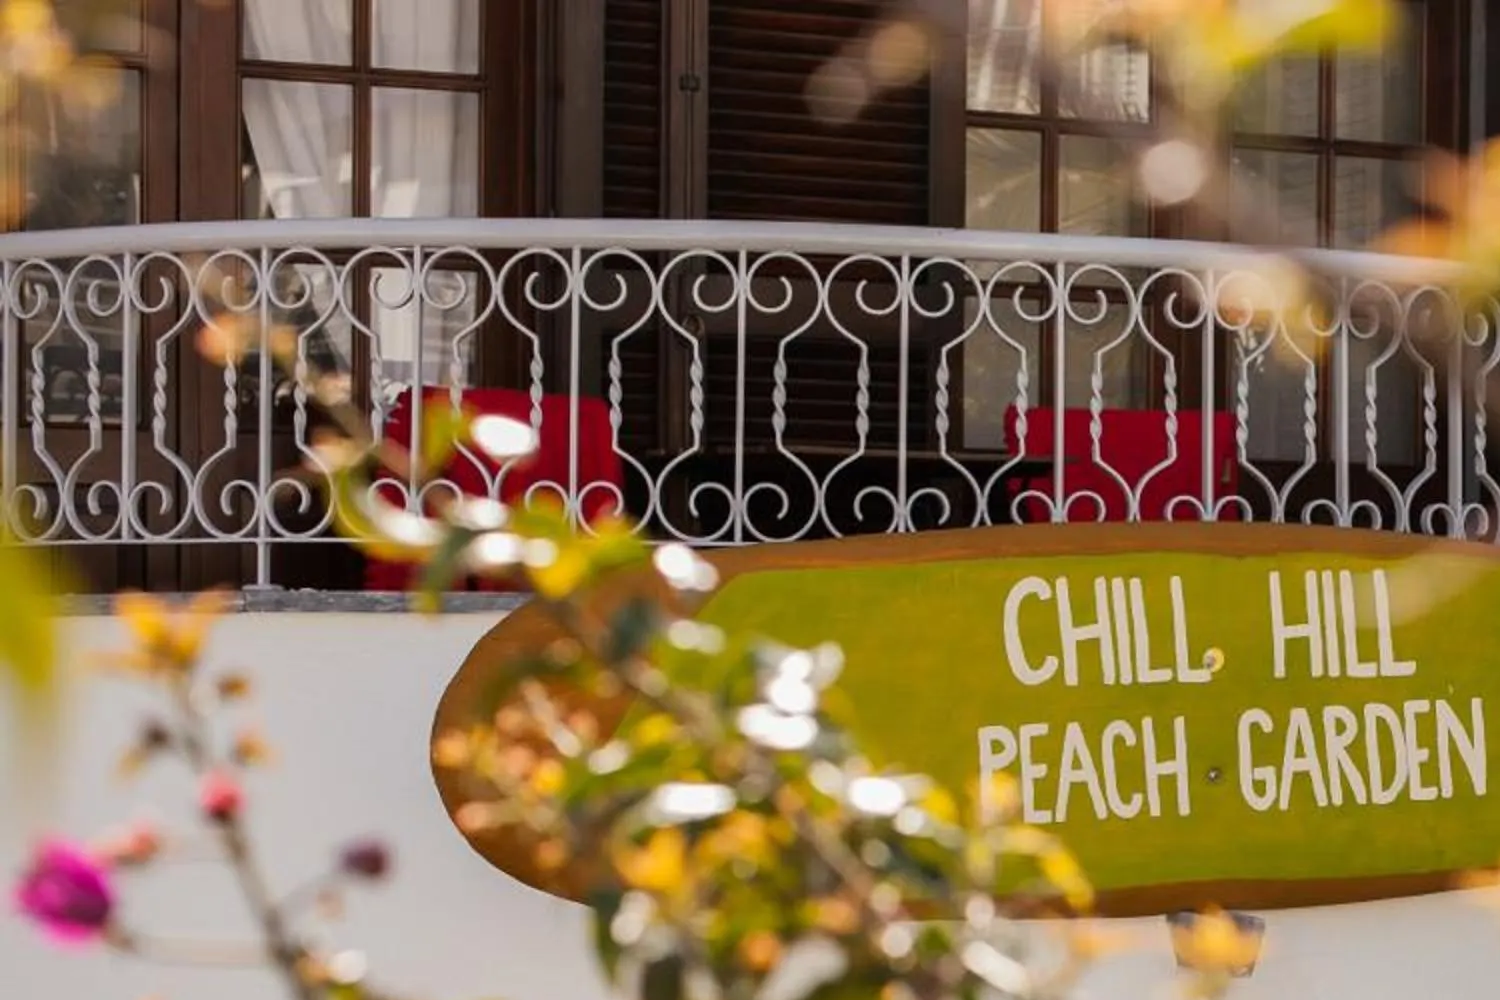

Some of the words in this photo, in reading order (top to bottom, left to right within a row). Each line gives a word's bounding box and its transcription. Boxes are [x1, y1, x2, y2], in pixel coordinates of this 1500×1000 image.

[1003, 576, 1212, 686] CHILL
[1269, 569, 1417, 679] HILL
[978, 716, 1190, 824] PEACH
[1238, 697, 1487, 812] GARDEN
